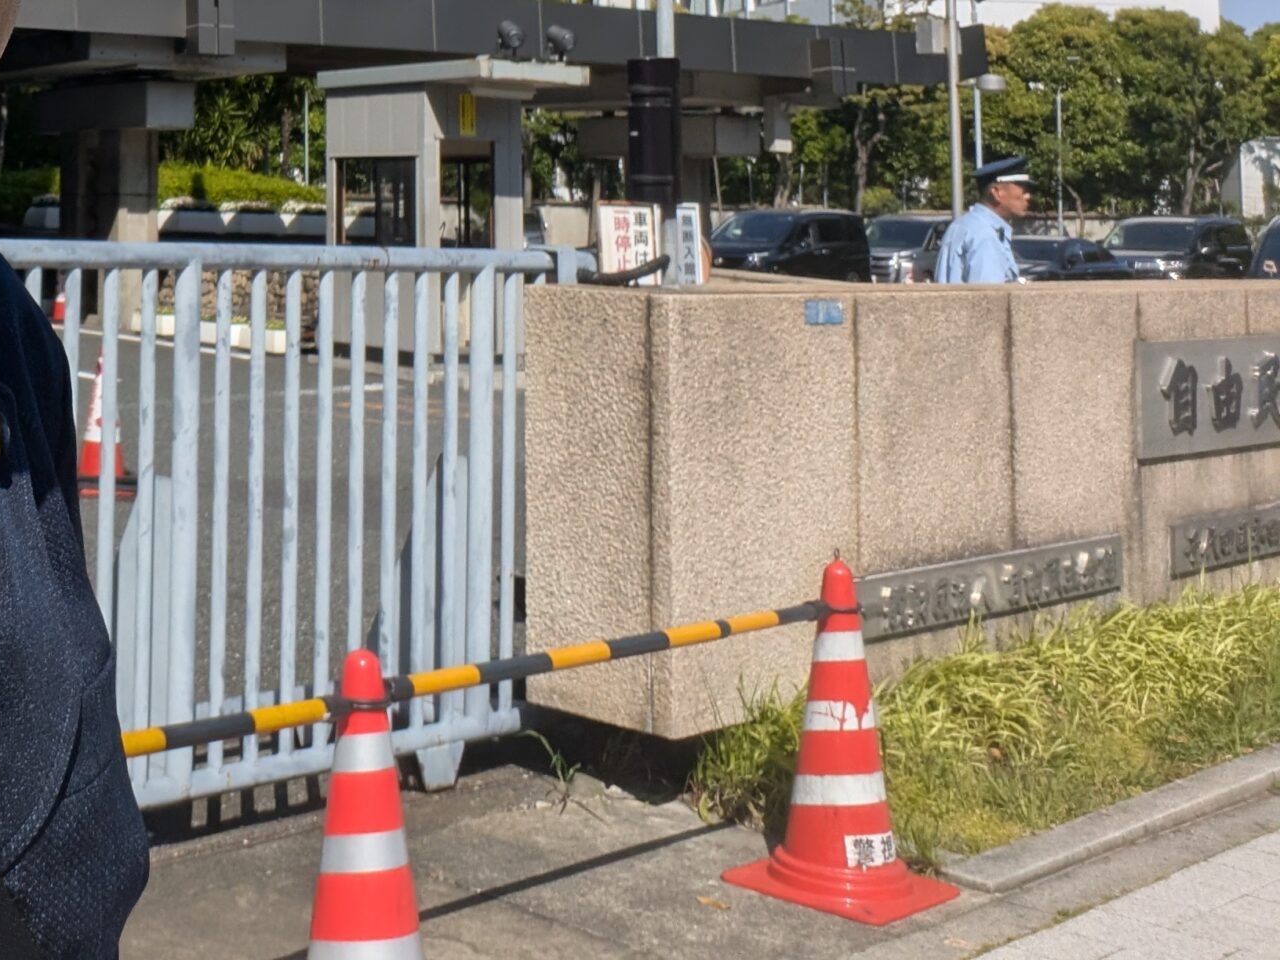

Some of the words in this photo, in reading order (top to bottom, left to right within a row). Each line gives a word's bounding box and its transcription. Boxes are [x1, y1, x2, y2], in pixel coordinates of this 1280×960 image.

[613, 209, 632, 272] 一時停止
[634, 211, 649, 265] 車両は
[1159, 350, 1280, 437] 自由民
